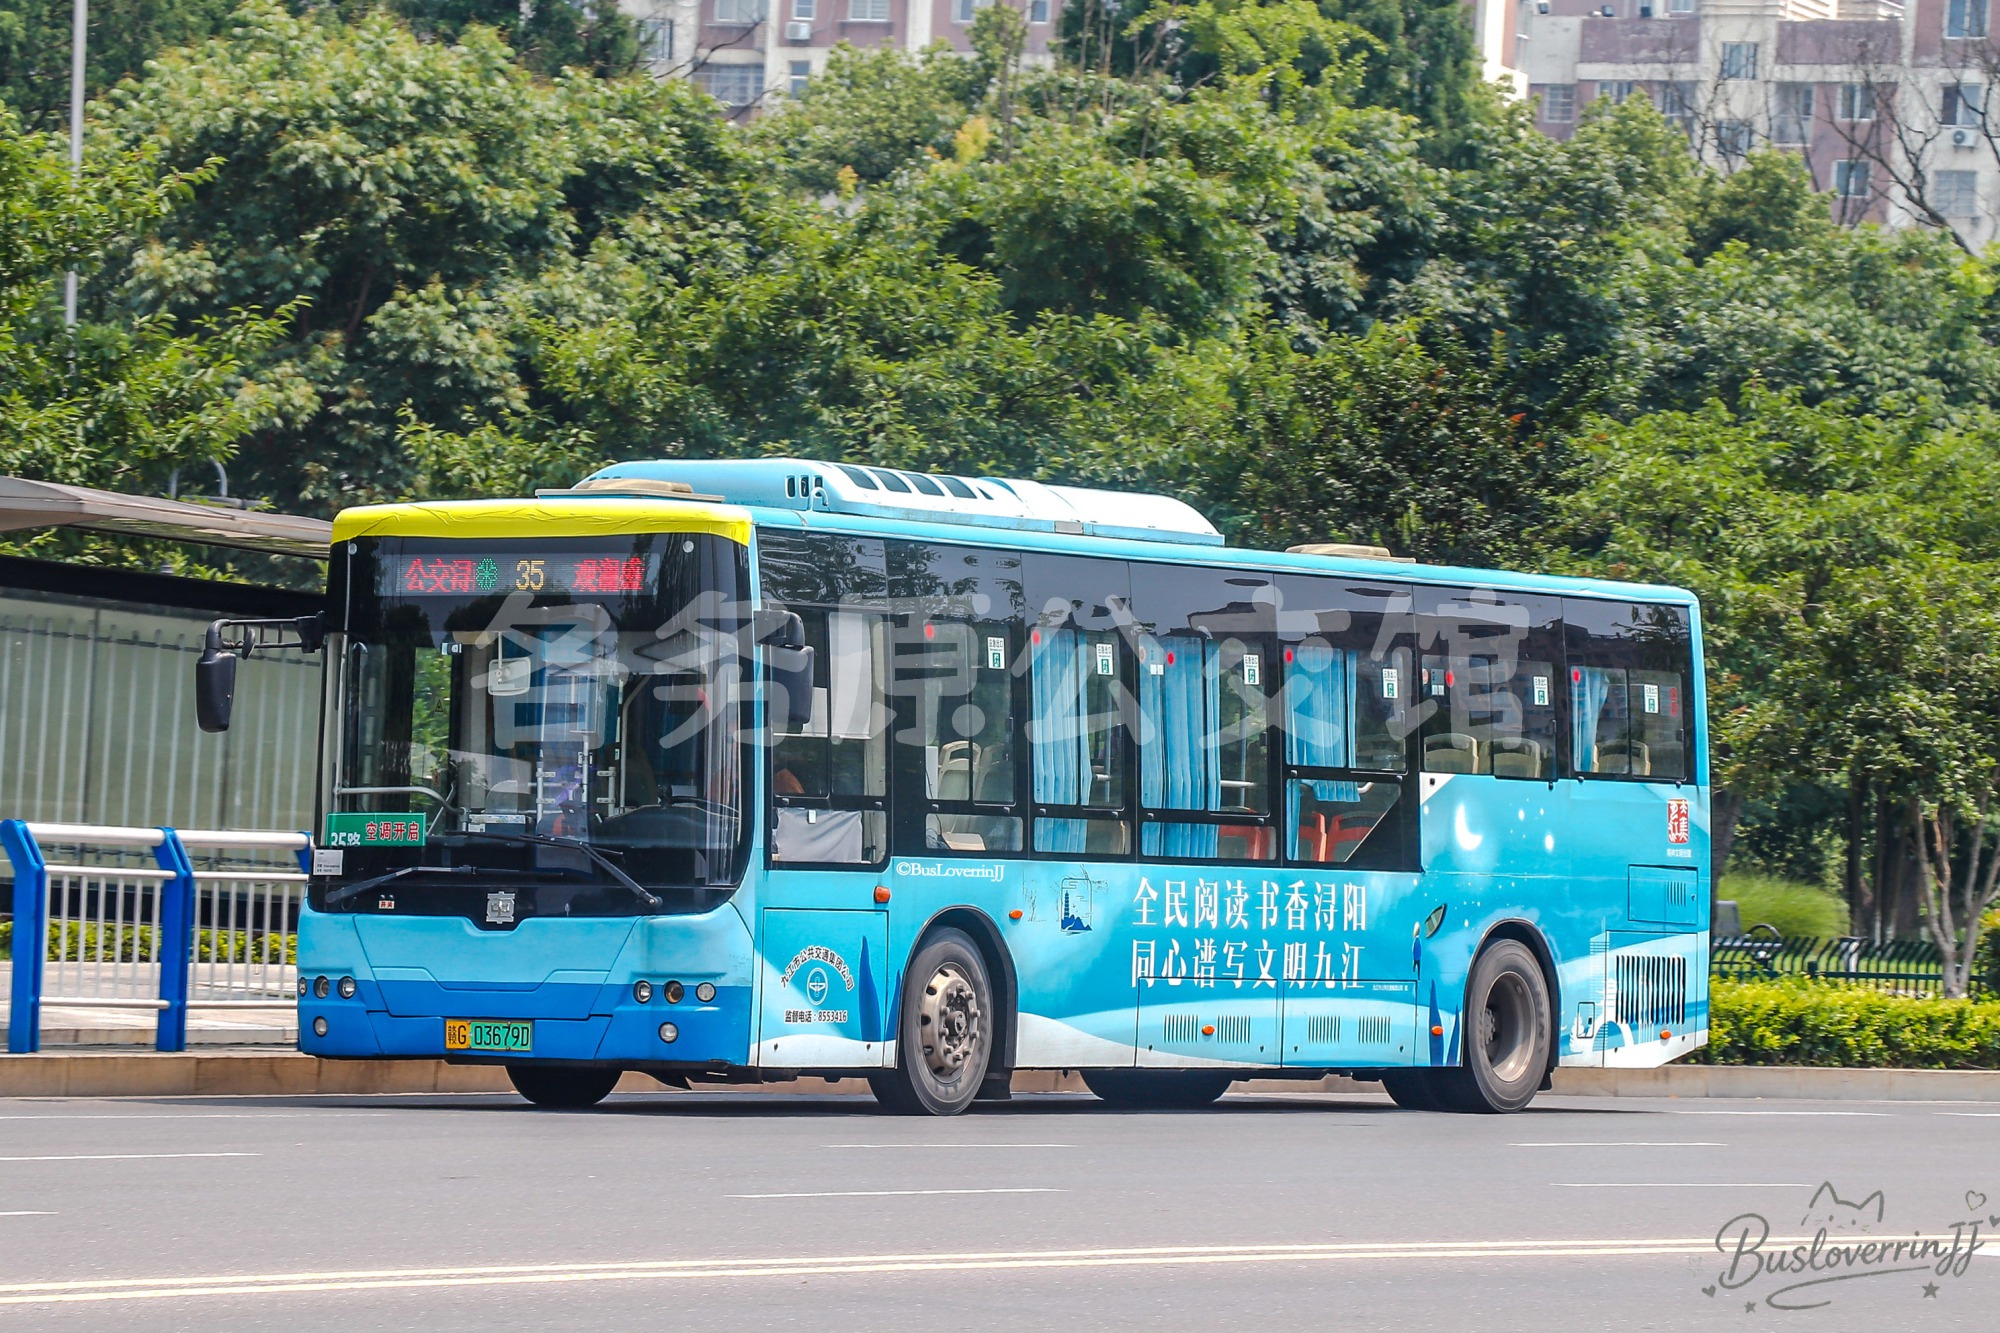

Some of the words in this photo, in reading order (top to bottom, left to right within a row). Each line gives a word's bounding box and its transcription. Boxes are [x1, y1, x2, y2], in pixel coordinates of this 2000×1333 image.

[516, 560, 546, 590] 35
[365, 821, 419, 842] 空调开启
[1132, 876, 1367, 931] 全民阅读书香浔阳
[780, 945, 854, 992] 九江市公共交通集团公司
[1131, 937, 1366, 990] 同心谱写文明九江
